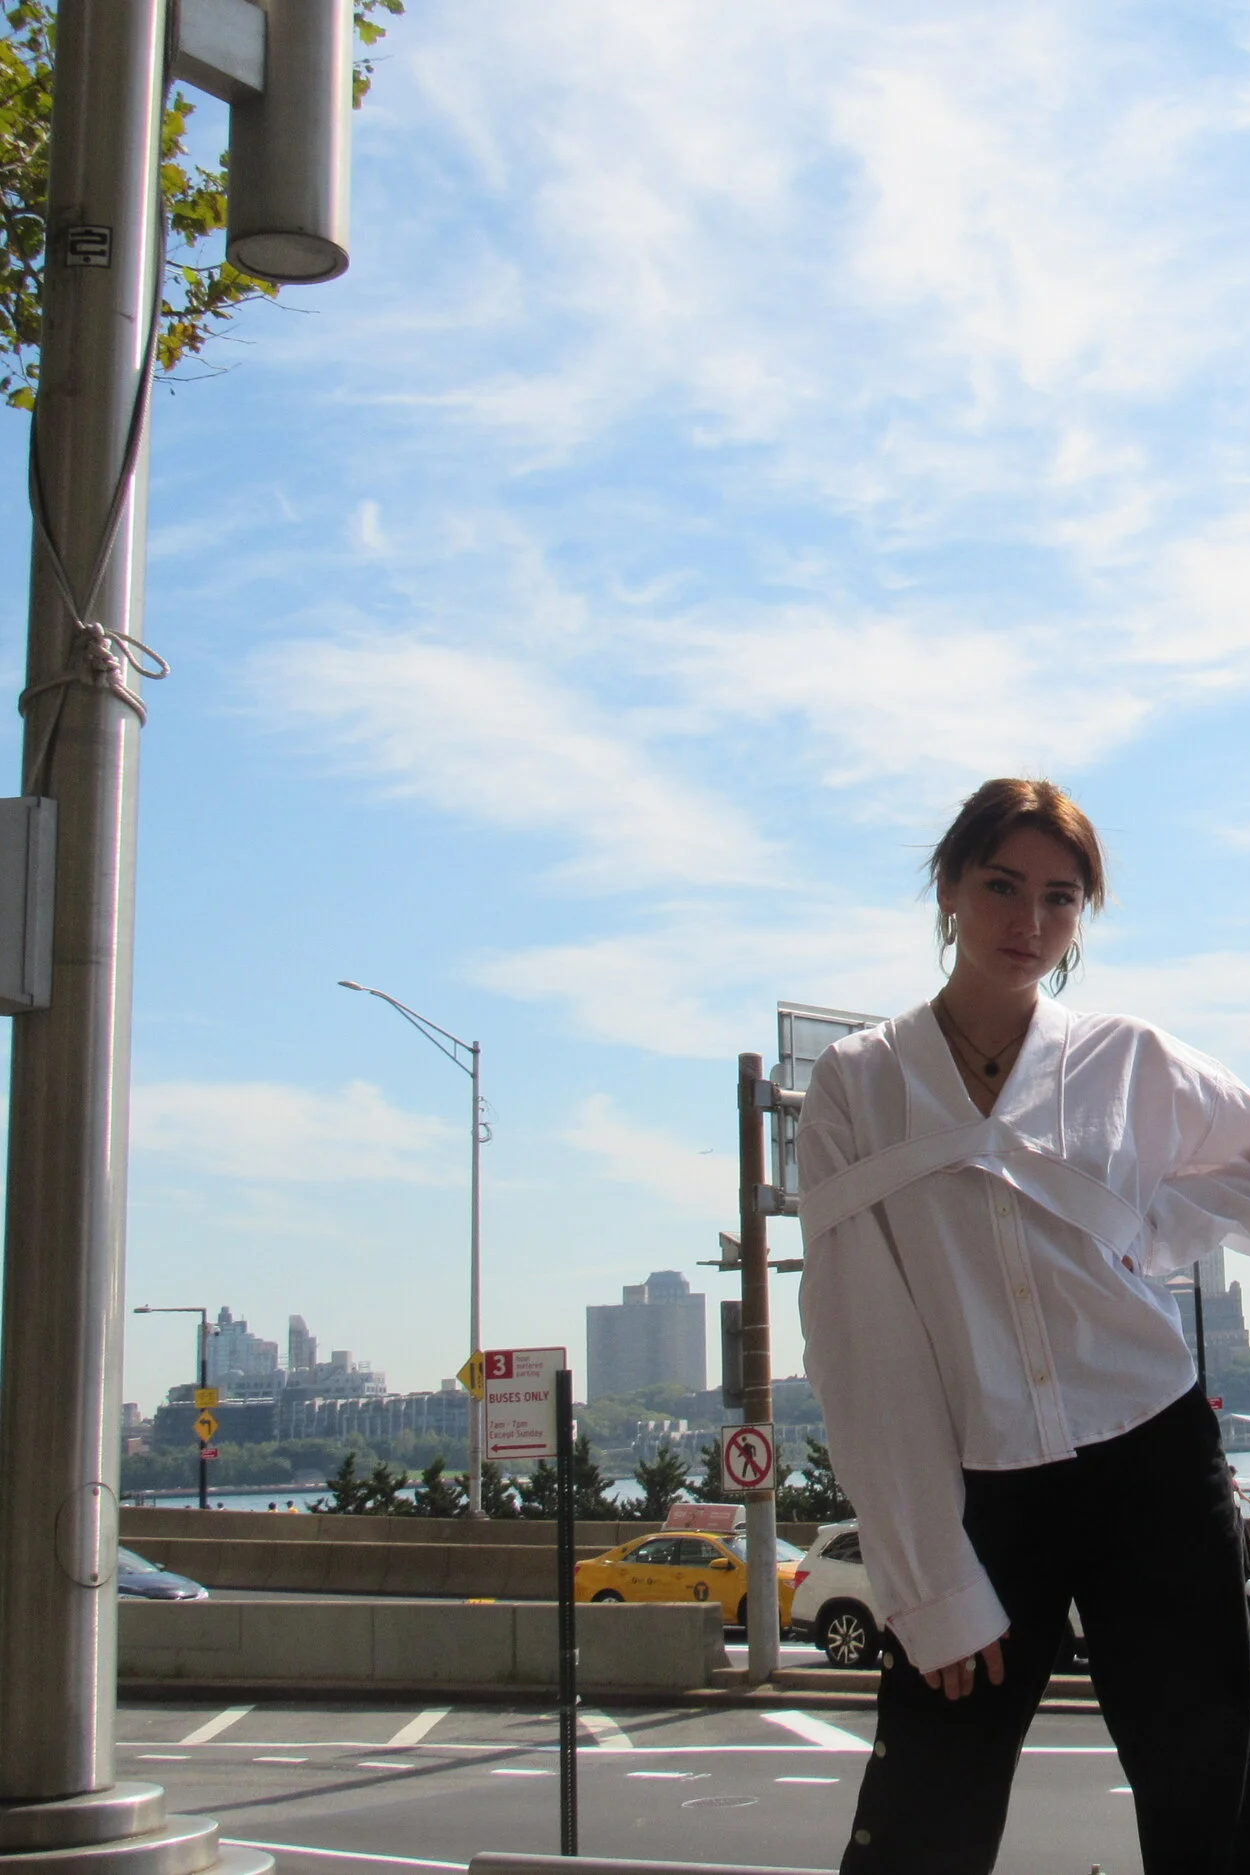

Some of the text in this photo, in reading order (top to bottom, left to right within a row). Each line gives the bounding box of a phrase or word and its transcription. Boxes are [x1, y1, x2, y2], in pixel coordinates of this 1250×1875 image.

[493, 1354, 506, 1376] 3
[489, 1390, 550, 1404] BUSES ONLY
[489, 1429, 543, 1440] Except Sunday
